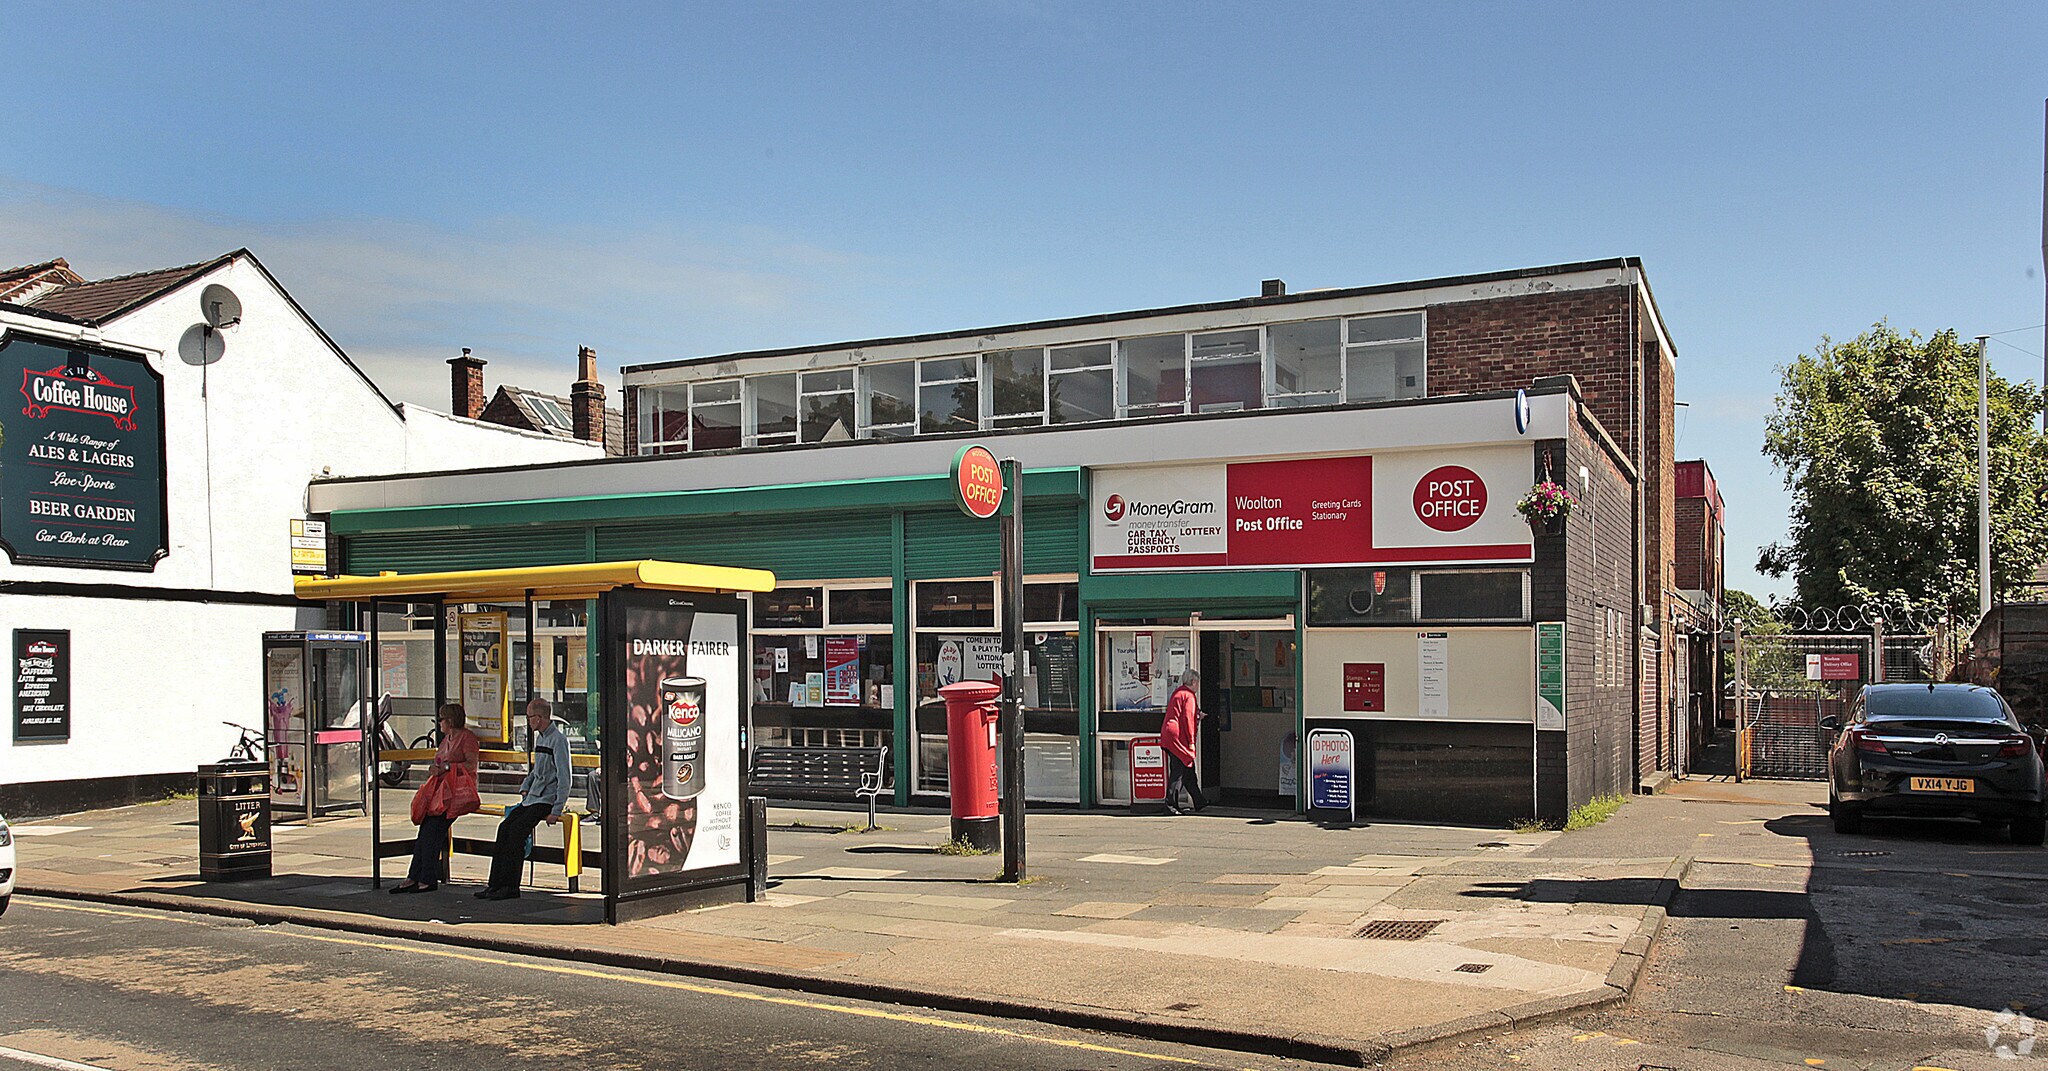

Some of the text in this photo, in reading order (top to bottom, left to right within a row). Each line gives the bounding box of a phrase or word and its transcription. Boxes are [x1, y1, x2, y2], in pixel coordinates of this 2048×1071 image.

[67, 366, 96, 380] THE
[33, 377, 128, 414] Coffee House
[43, 431, 120, 451] A Wide Range of
[28, 444, 135, 468] ALES & LAGERS
[971, 464, 994, 485] POST
[50, 471, 117, 492] Live Sports
[966, 483, 998, 505] OFFICE
[1429, 480, 1475, 498] POST
[1129, 500, 1215, 519] MoneyGram
[1235, 496, 1282, 510] Woolton
[1312, 499, 1363, 511] Greeting Cards
[1420, 500, 1480, 518] OFFICE
[30, 500, 136, 522] BEER GARDEN
[1312, 511, 1348, 521] Stationary
[1129, 519, 1191, 530] money transfer
[1236, 516, 1304, 532] Post Office
[36, 529, 130, 547] Car Park at Rear
[1127, 530, 1168, 538] CAR TAX
[1180, 527, 1222, 536] LOTTERY
[1127, 537, 1176, 546] CURRENCY
[1127, 545, 1181, 554] PASSPORTS
[965, 636, 983, 644] COME
[633, 638, 730, 656] DARKER FAIRER
[668, 703, 701, 721] Kenco
[565, 727, 579, 736] TAX
[667, 726, 702, 738] MILLICANO
[1312, 740, 1350, 752] ID PHOTOS
[1321, 754, 1341, 766] Here
[1917, 778, 1968, 791] VX14 YJG
[235, 801, 261, 811] LITTER
[713, 802, 732, 810] KENCO
[709, 816, 732, 825] WITHOUT
[702, 824, 732, 833] COMPROMISE
